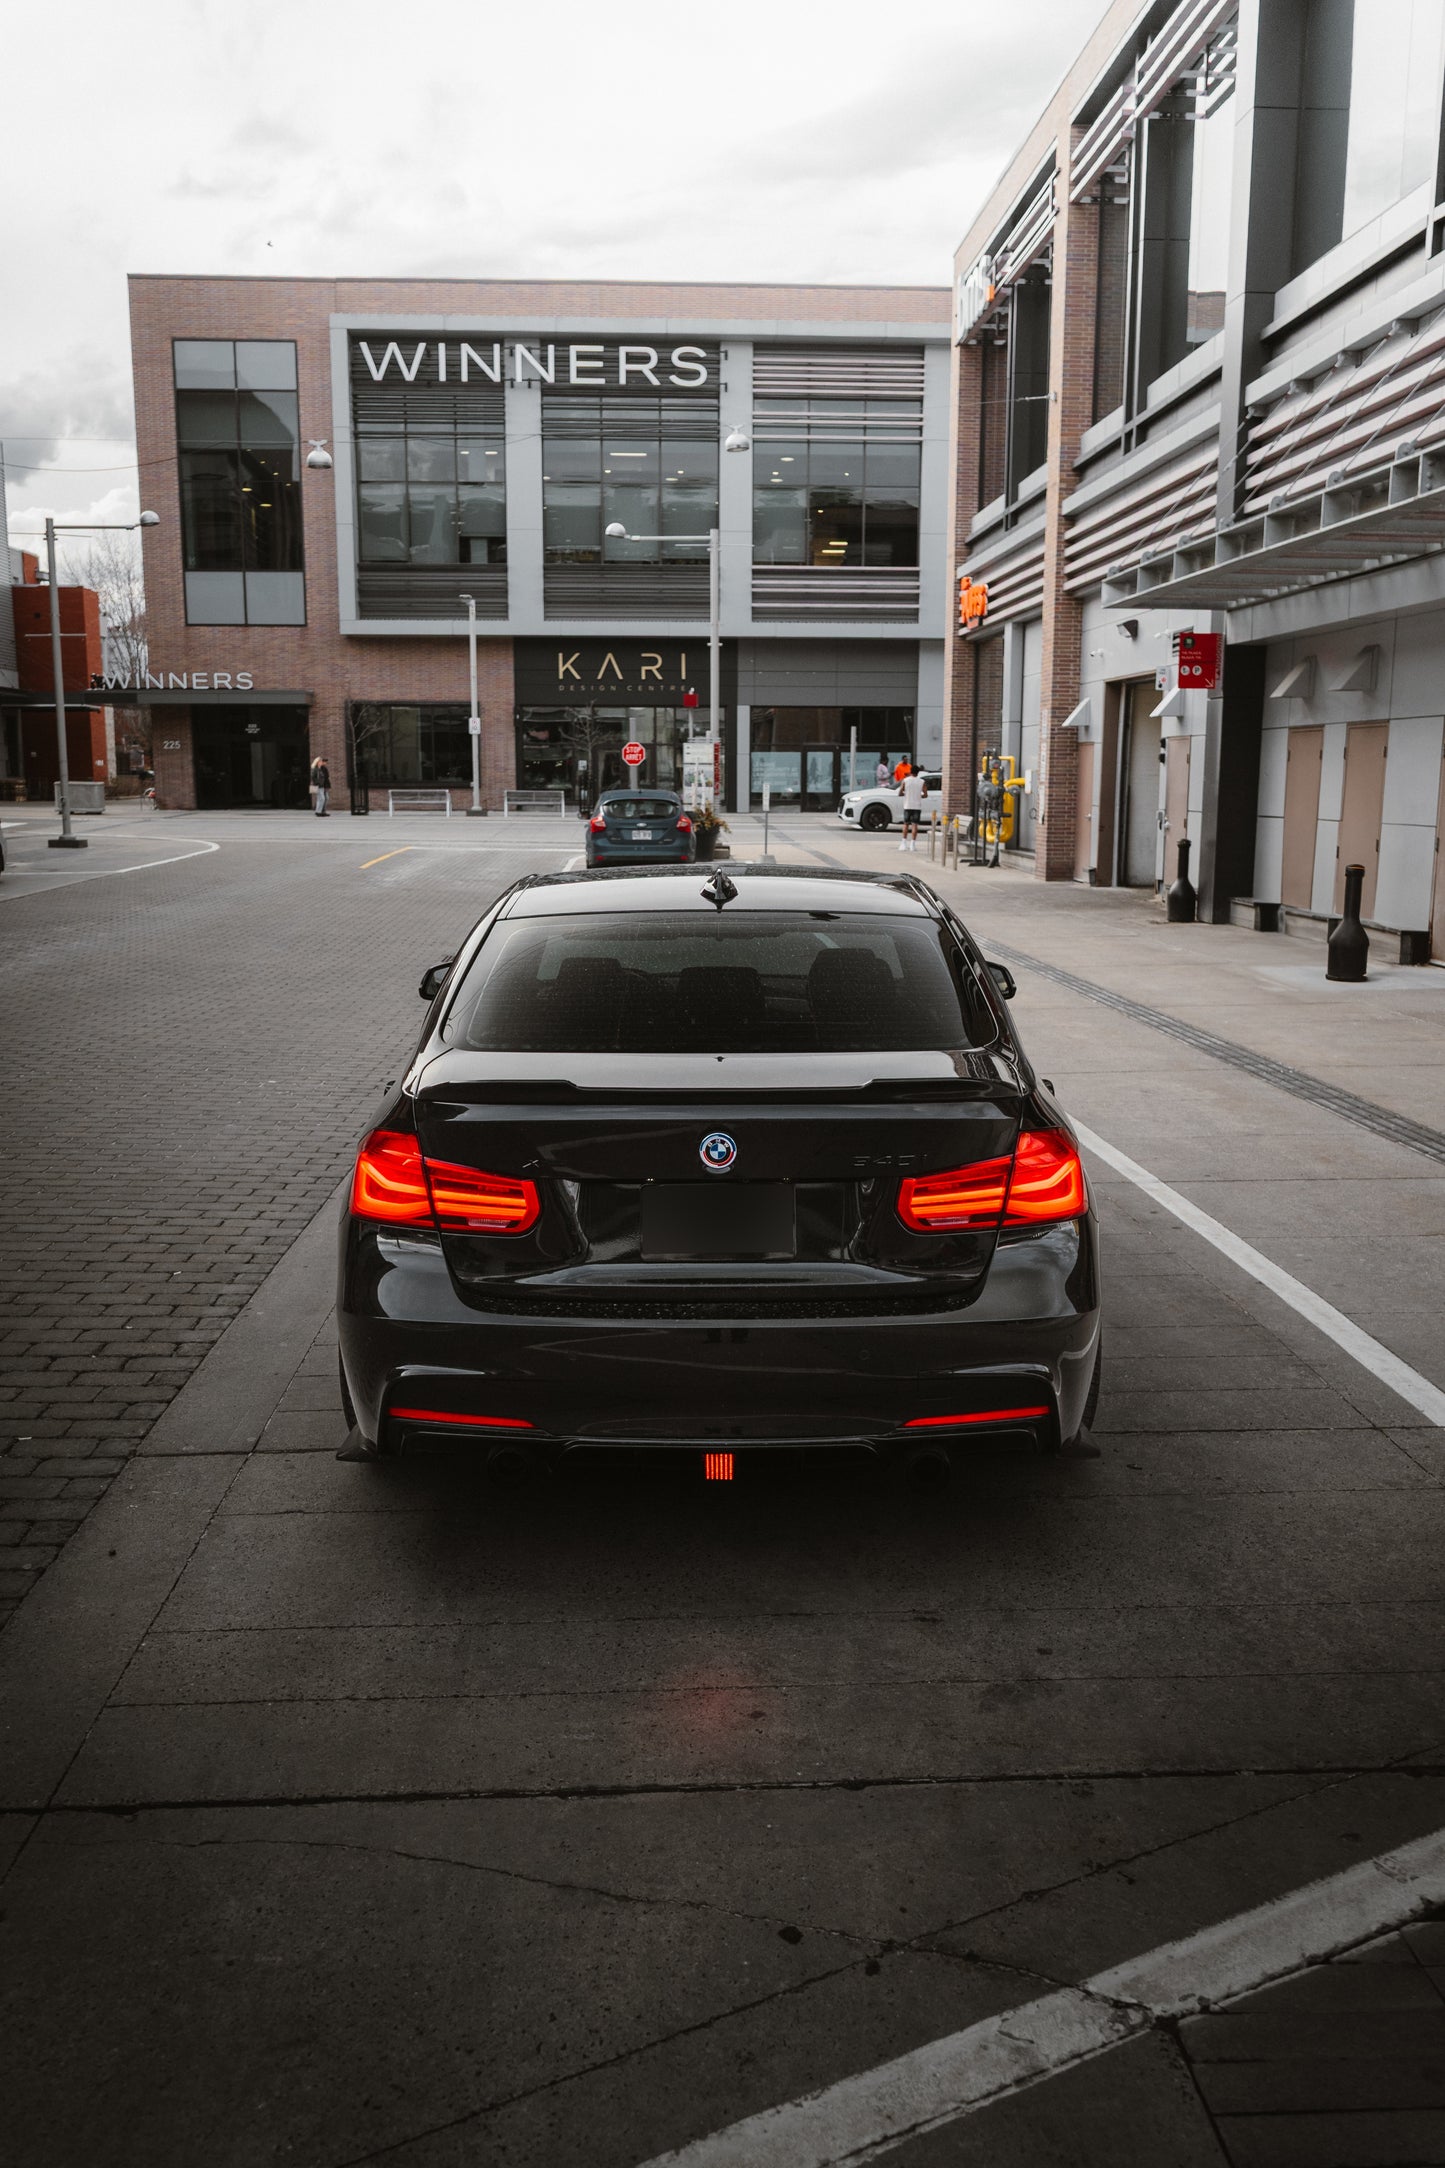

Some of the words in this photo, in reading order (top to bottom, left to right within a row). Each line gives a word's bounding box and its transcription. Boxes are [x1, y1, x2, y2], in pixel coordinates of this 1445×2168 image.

[358, 341, 709, 387] WINNERS
[558, 652, 687, 680] KARI
[102, 672, 254, 690] WINNERS
[558, 684, 617, 692] DESIGN
[626, 684, 687, 692] CENTRE
[162, 740, 181, 750] 225
